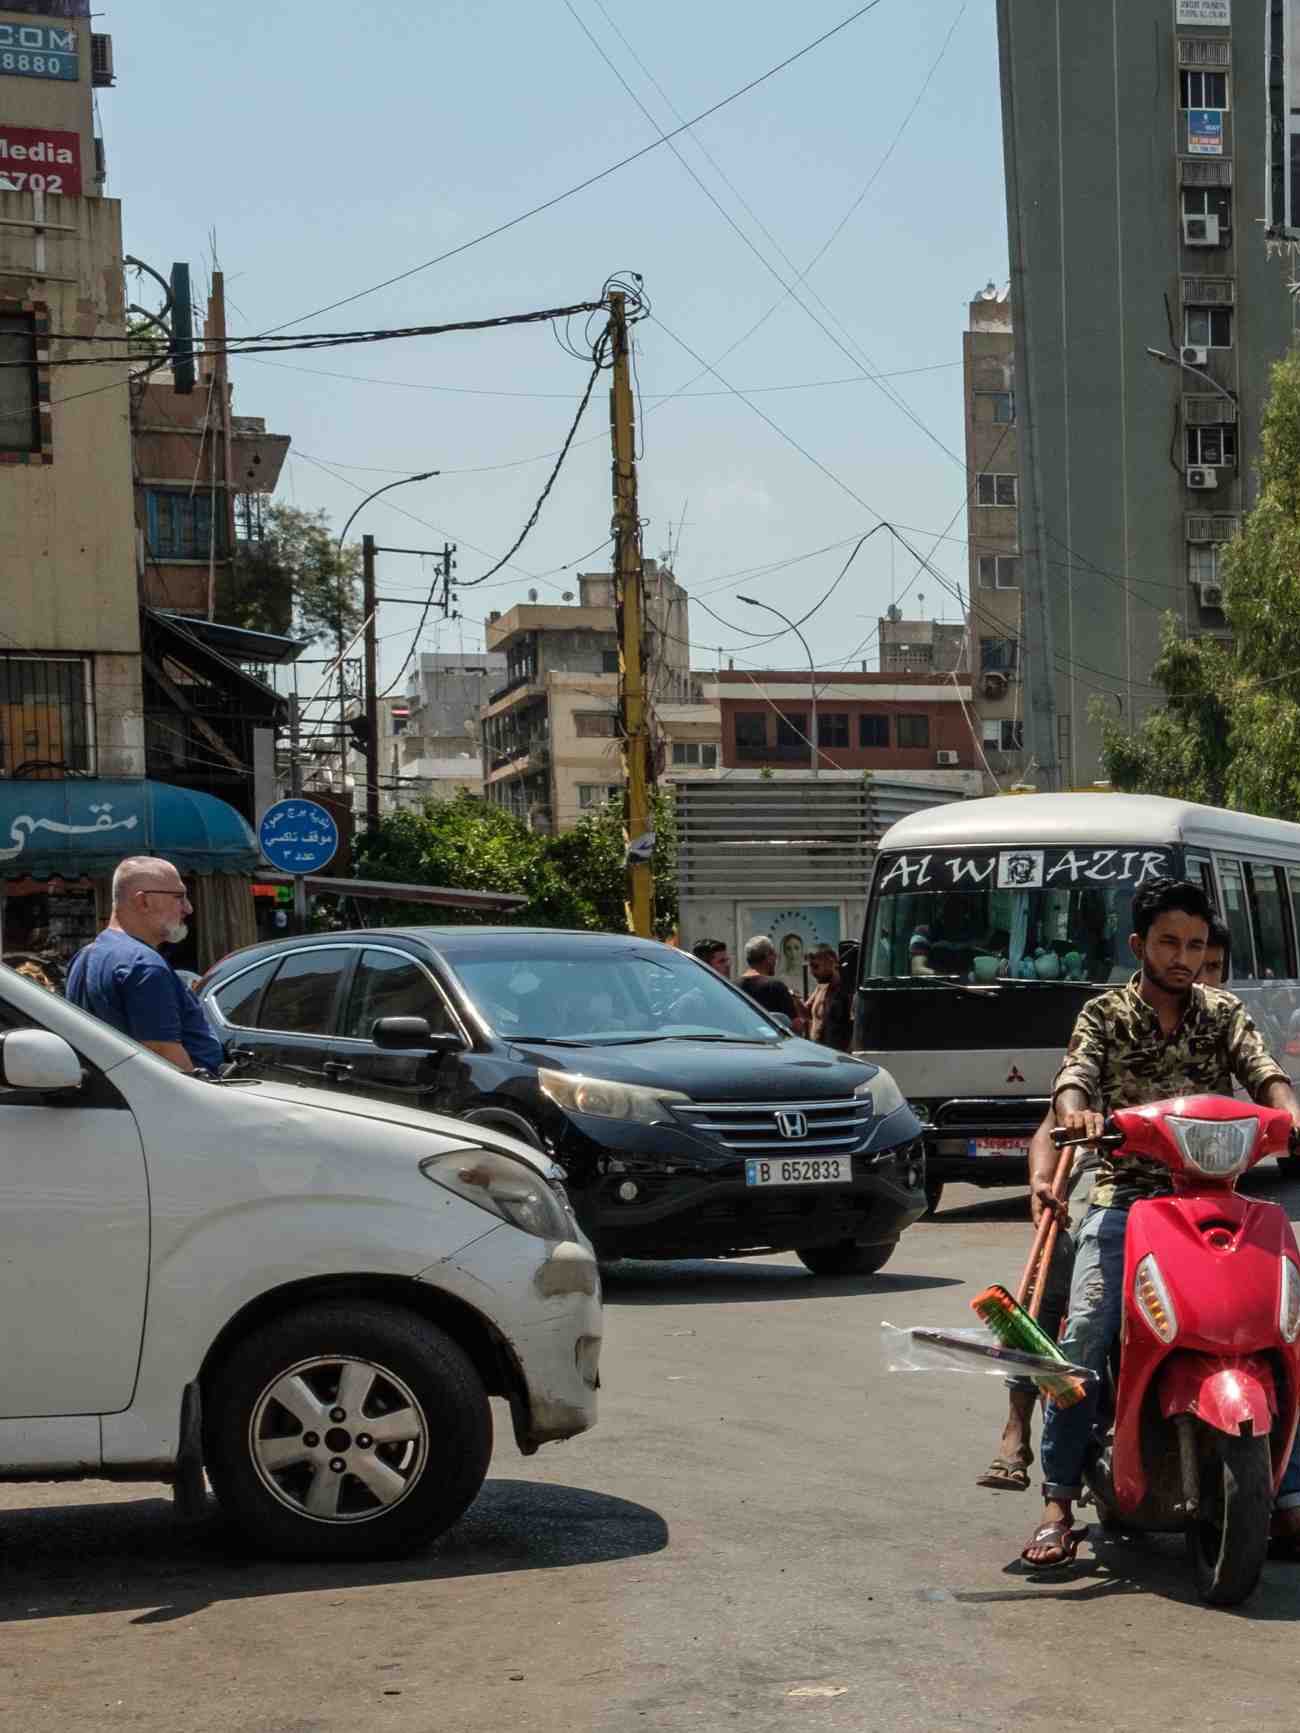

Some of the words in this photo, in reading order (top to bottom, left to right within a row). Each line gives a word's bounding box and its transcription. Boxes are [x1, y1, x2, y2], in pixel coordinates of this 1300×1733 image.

[264, 831, 299, 847] تاكسي
[301, 830, 332, 846] موقف
[945, 857, 996, 883] W
[1046, 850, 1167, 888] AZIR
[759, 1162, 770, 1182] B
[781, 1160, 840, 1181] 652833
